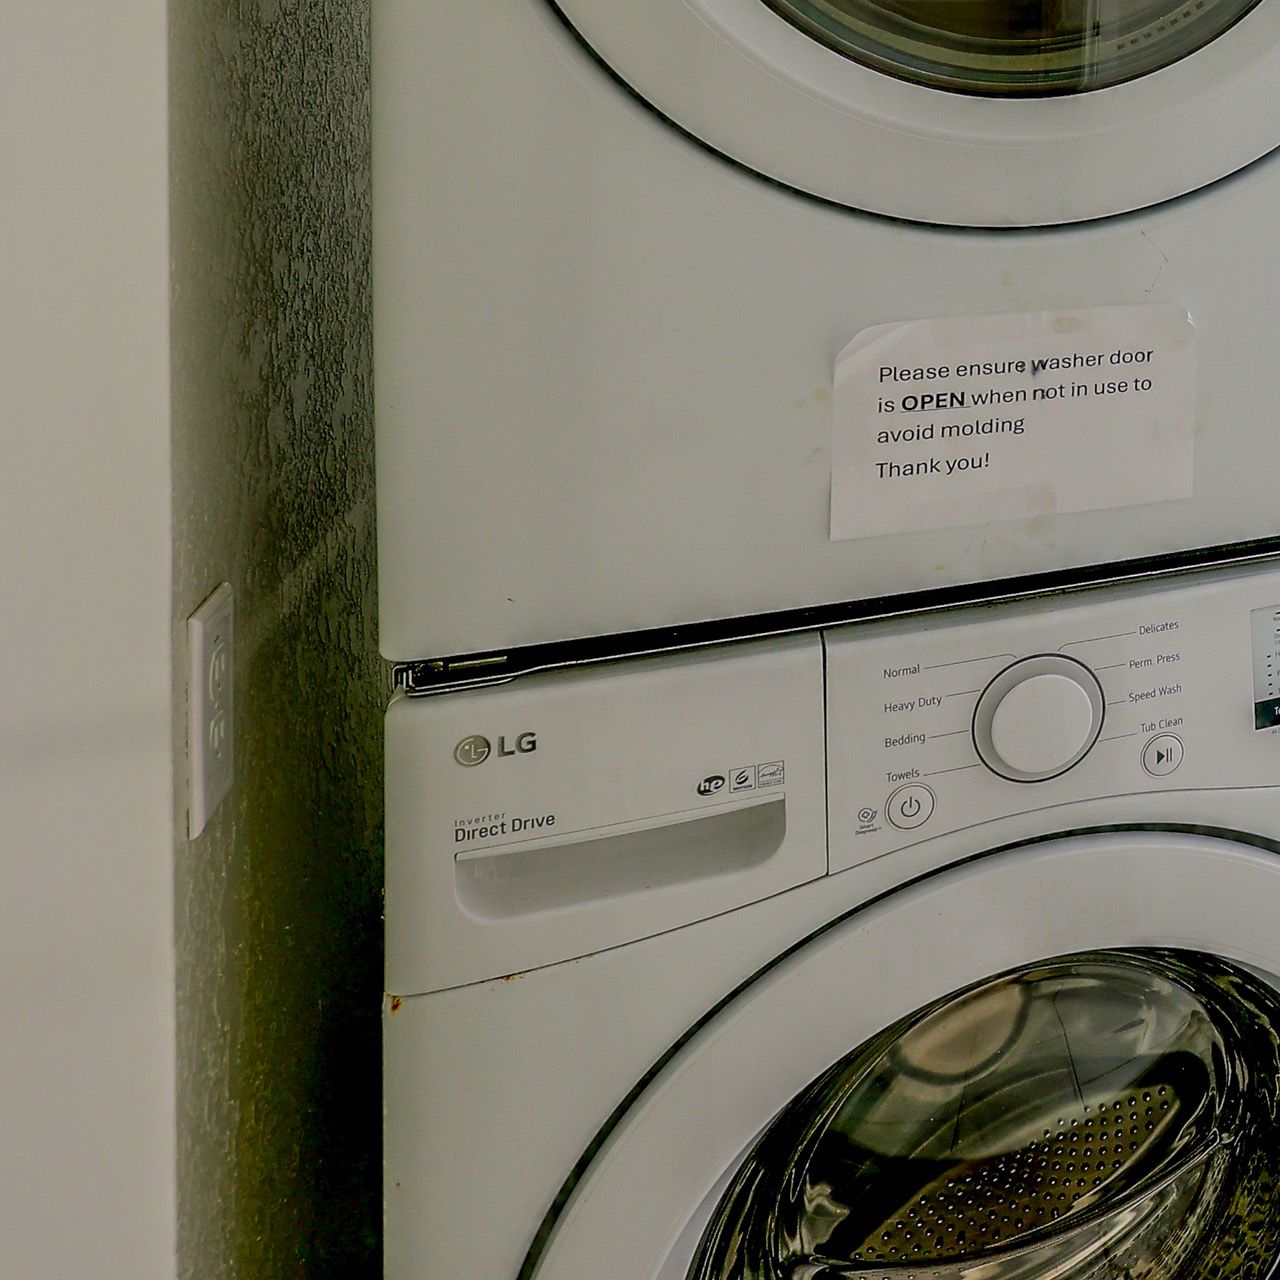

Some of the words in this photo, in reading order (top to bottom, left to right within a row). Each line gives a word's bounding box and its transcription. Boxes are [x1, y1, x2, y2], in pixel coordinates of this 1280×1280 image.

[880, 366, 950, 382] Please
[956, 360, 1026, 377] ensure
[1032, 354, 1104, 371] washer
[1110, 350, 1154, 364] door
[878, 398, 895, 413] is
[901, 392, 966, 412] OPEN
[971, 389, 1026, 406] when
[1033, 384, 1065, 400] not
[1072, 382, 1088, 397] in
[1094, 380, 1128, 395] use
[1133, 378, 1152, 392] to
[878, 424, 934, 444] avoid
[941, 418, 1025, 438] molding
[876, 458, 942, 478] Thank
[946, 452, 989, 476] you!
[1140, 621, 1180, 635] Delicates
[1156, 653, 1180, 664] Press
[884, 664, 920, 678] Normal
[1129, 688, 1156, 703] Speed
[1158, 684, 1182, 696] Wash
[884, 702, 915, 712] Heavy
[918, 696, 942, 707] Duty
[1140, 722, 1156, 733] Tub
[1158, 716, 1183, 729] Clean
[497, 732, 537, 758] LG
[884, 734, 926, 748] Bedding
[886, 768, 920, 782] Towels
[454, 812, 506, 828] Inverter
[454, 823, 506, 842] Direct
[512, 814, 556, 832] Drive
